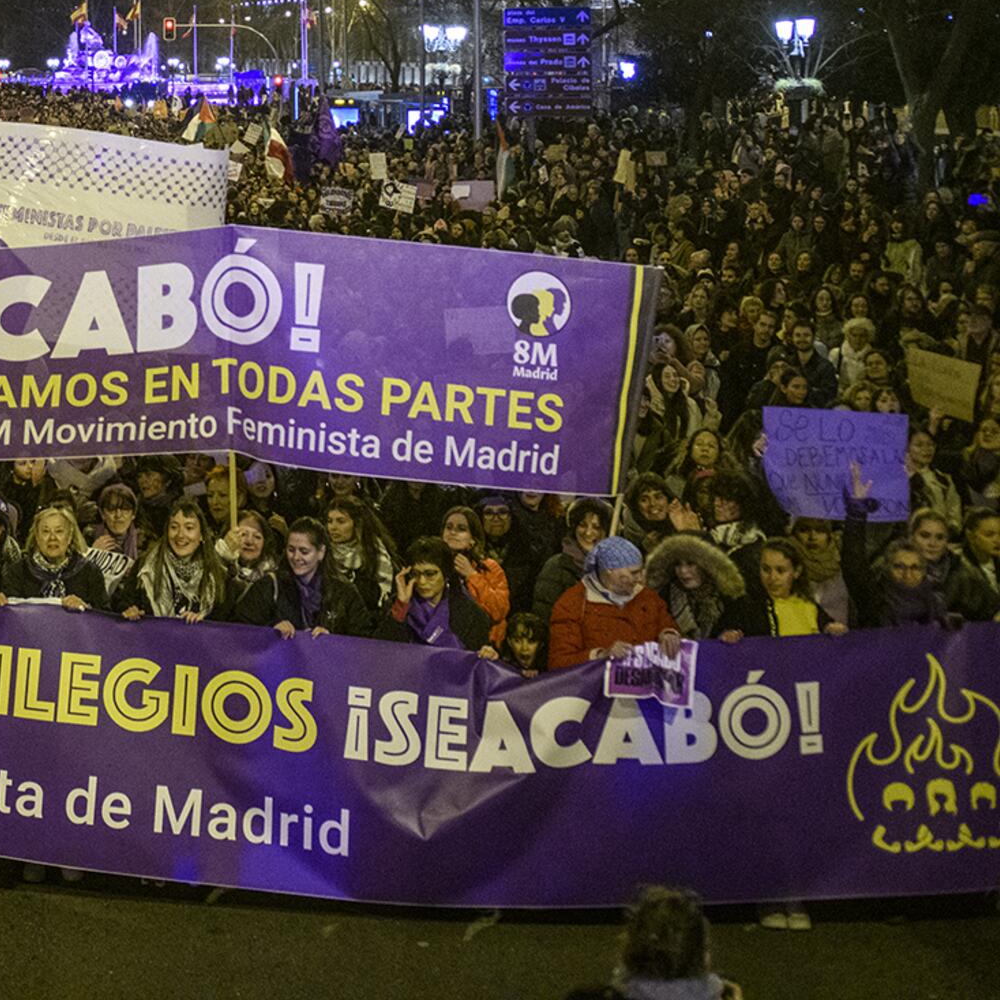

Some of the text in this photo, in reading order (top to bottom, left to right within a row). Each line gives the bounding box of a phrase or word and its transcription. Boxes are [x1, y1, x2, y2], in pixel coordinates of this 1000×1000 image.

[528, 35, 562, 44] Thyssen
[540, 58, 563, 66] Prado
[87, 216, 123, 237] POR
[513, 339, 558, 367] 8M
[512, 365, 558, 381] Madrid
[144, 362, 200, 405] EN
[211, 357, 365, 414] TODAS
[379, 376, 565, 433] PARTES
[22, 411, 218, 445] Movimiento
[226, 406, 381, 459] Feminista
[391, 429, 434, 464] de
[443, 434, 561, 476] Madrid
[65, 775, 133, 830] de
[153, 784, 351, 857] Madrid
